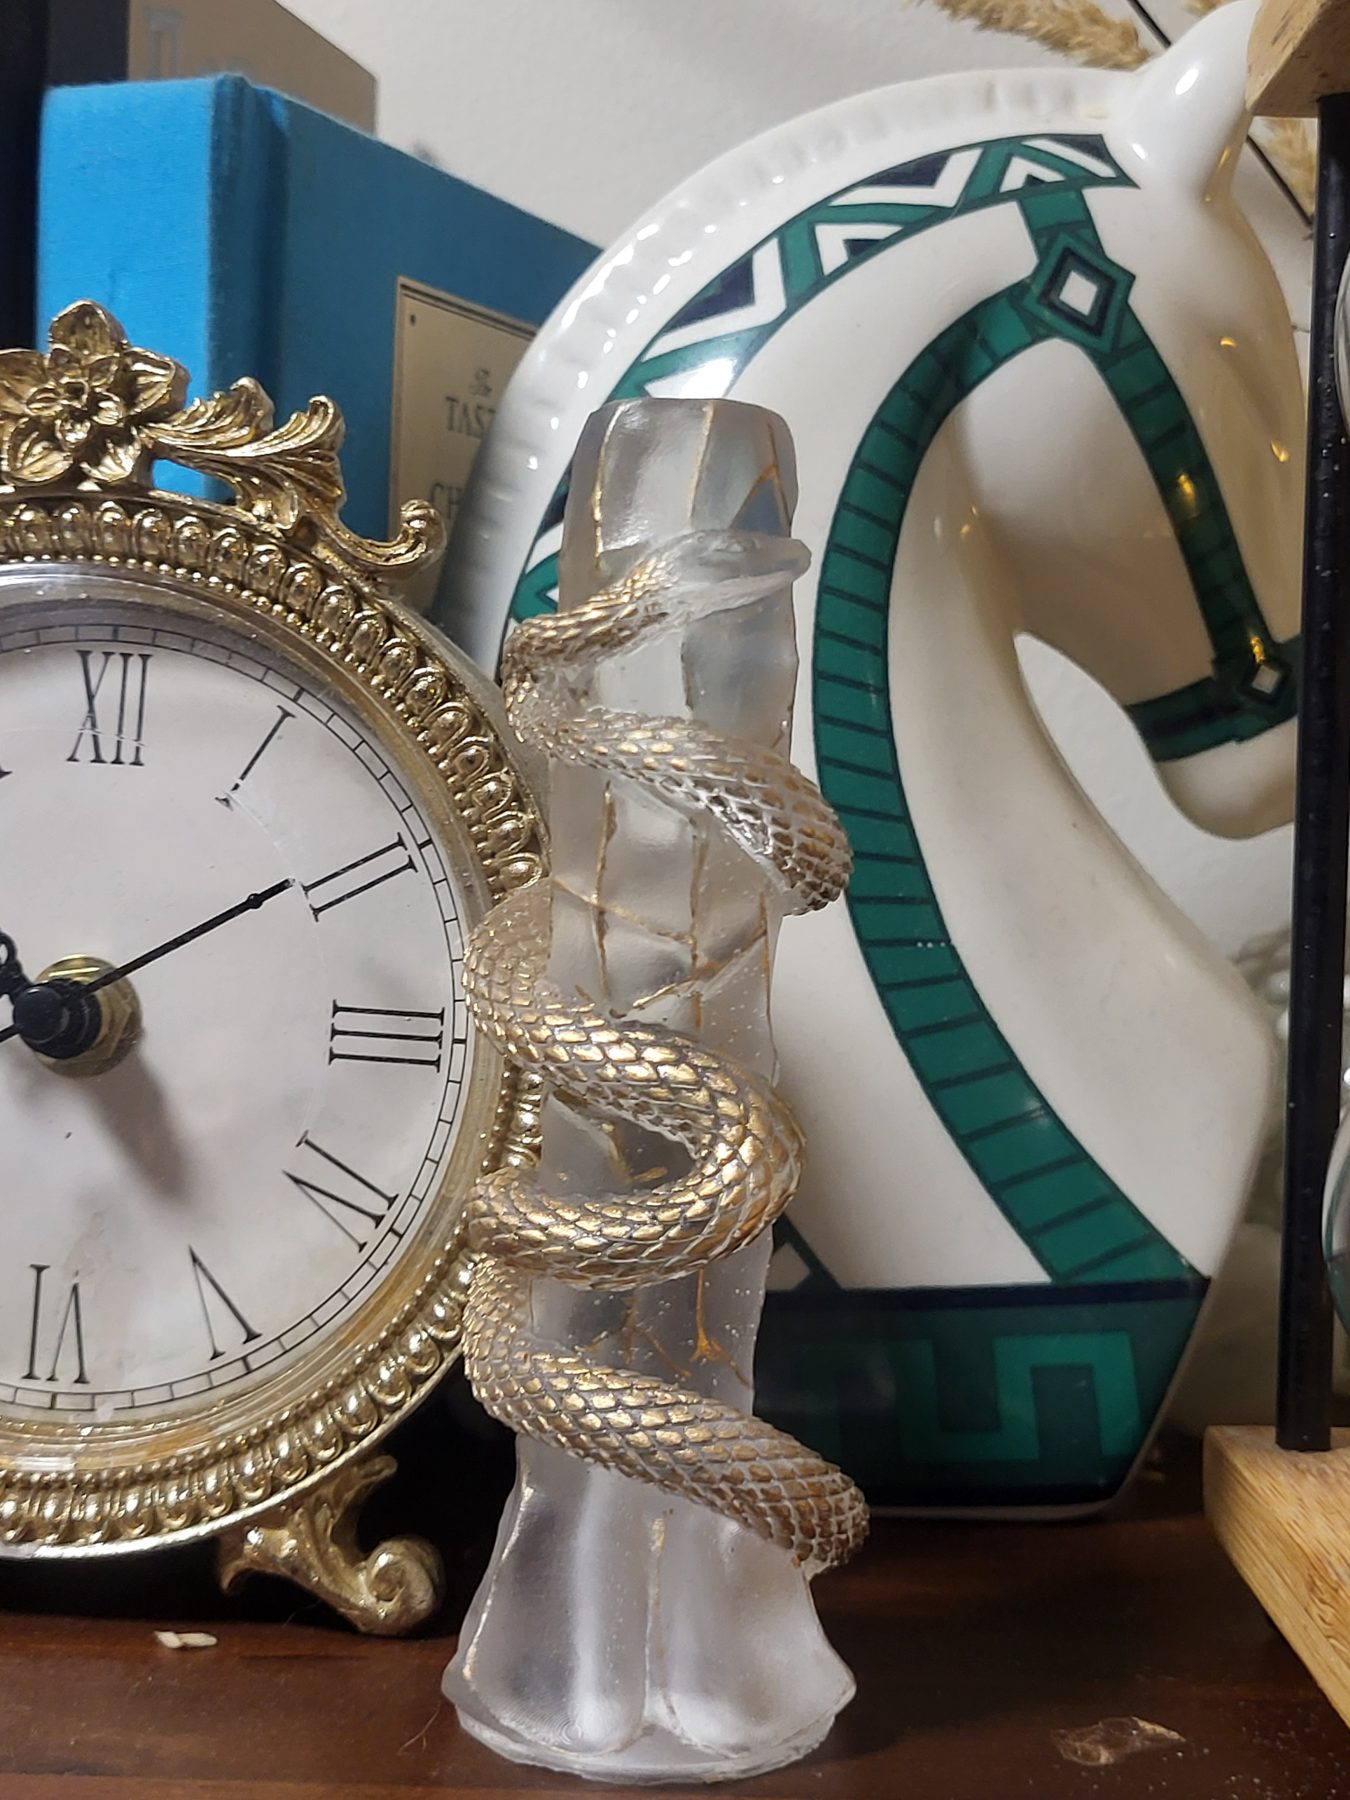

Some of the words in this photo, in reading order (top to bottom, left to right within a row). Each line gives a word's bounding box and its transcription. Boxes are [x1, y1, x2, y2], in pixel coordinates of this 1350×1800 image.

[66, 649, 153, 767] XII
[300, 832, 419, 922] II
[328, 1000, 446, 1073] III
[188, 1245, 262, 1361] V
